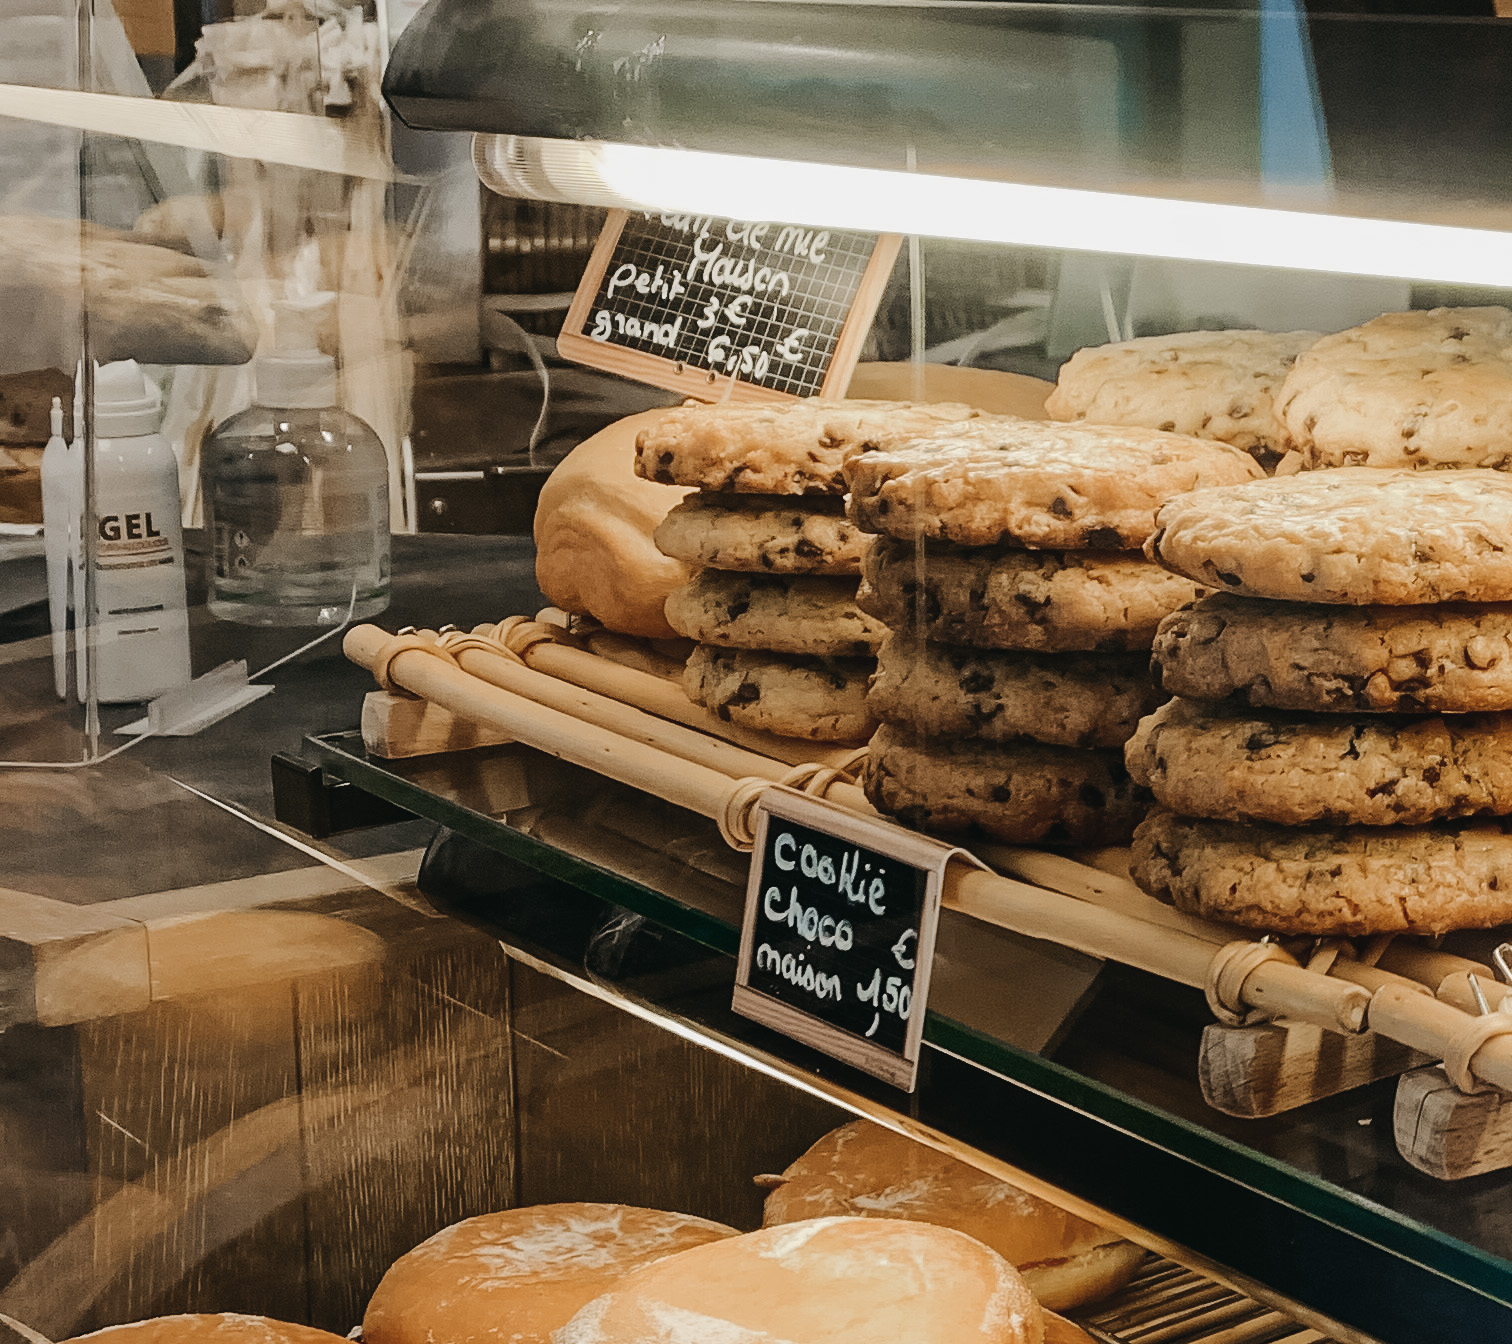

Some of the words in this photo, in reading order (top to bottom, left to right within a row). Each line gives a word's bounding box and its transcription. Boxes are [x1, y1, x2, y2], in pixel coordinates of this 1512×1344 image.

[775, 226, 830, 263] mie
[687, 237, 790, 296] Maison
[590, 309, 682, 348] grand
[98, 512, 161, 540] GEL
[757, 943, 842, 1001] maison
